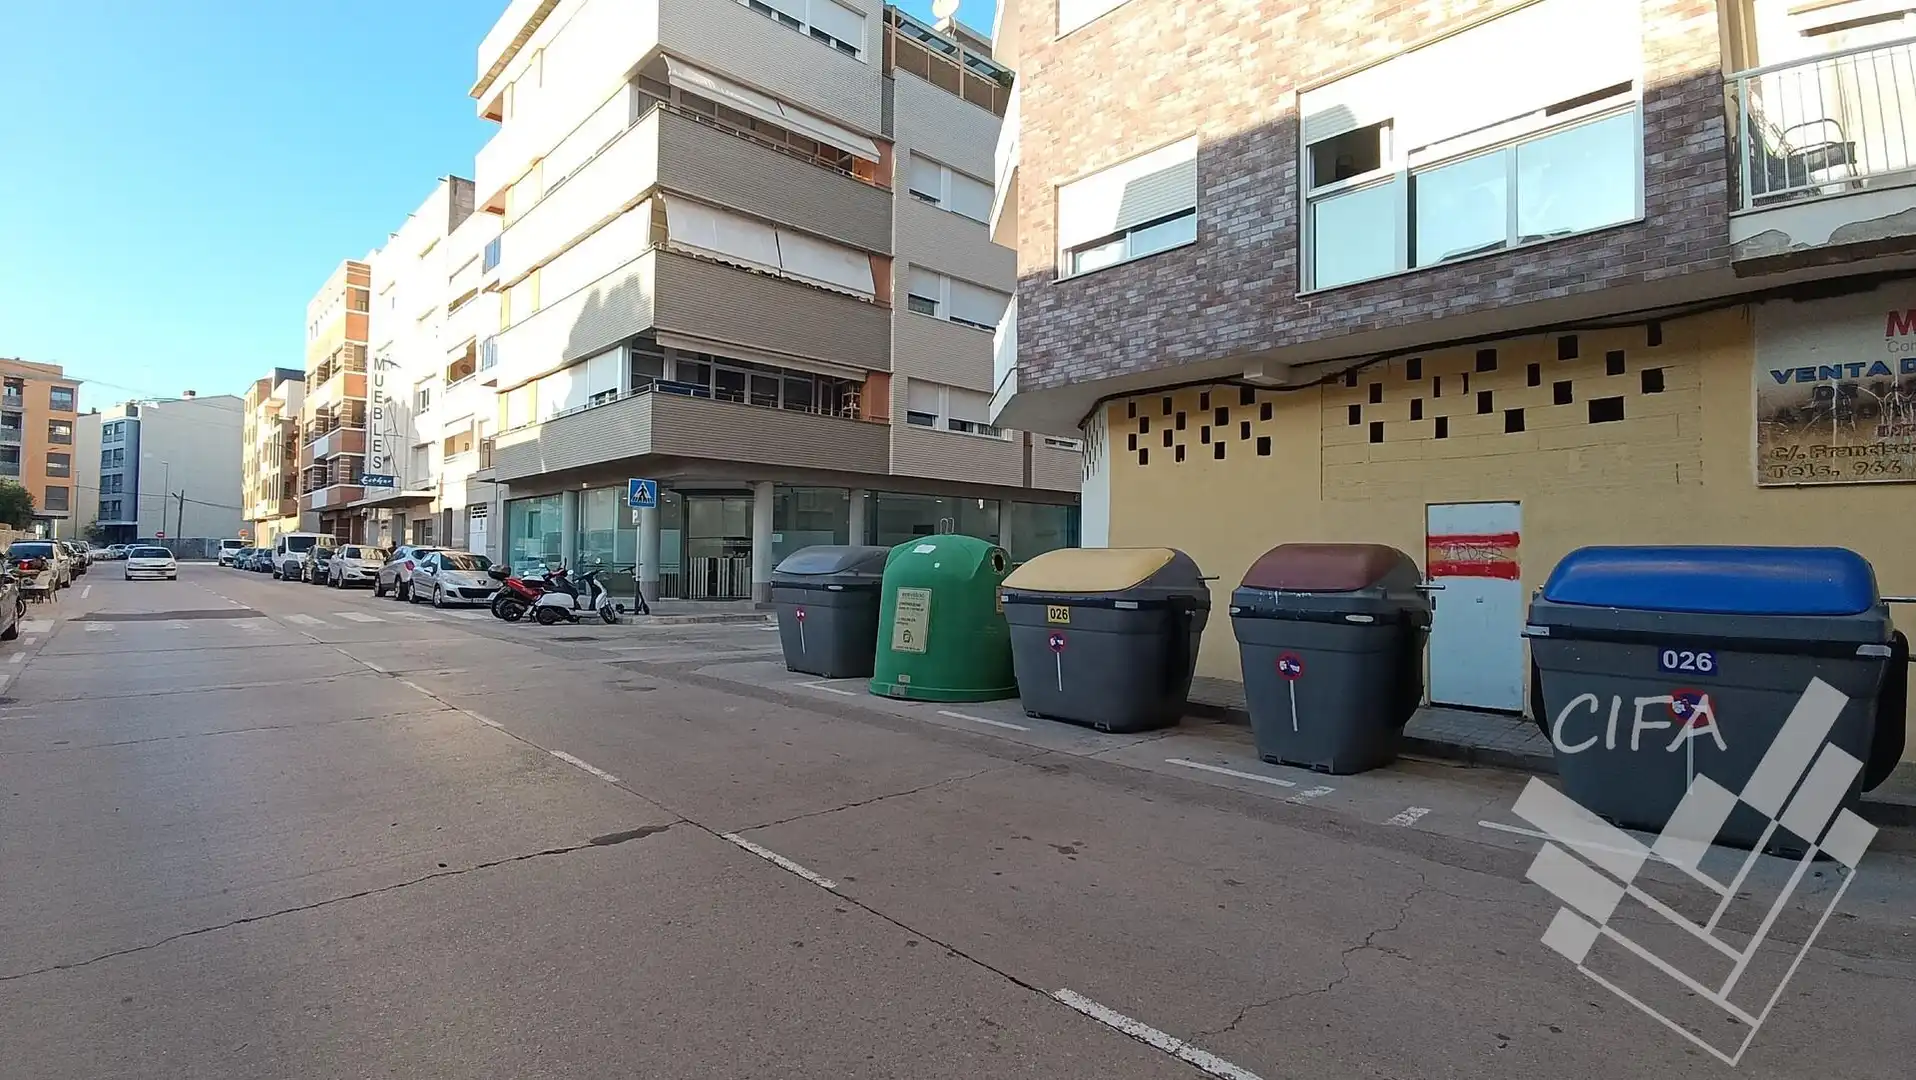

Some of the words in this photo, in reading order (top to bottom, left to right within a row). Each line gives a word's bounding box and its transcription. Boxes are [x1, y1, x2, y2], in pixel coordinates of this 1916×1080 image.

[1770, 361, 1892, 384] VENTA
[373, 358, 384, 469] MUEBLES
[1050, 607, 1068, 620] 026
[1662, 650, 1713, 671] 026
